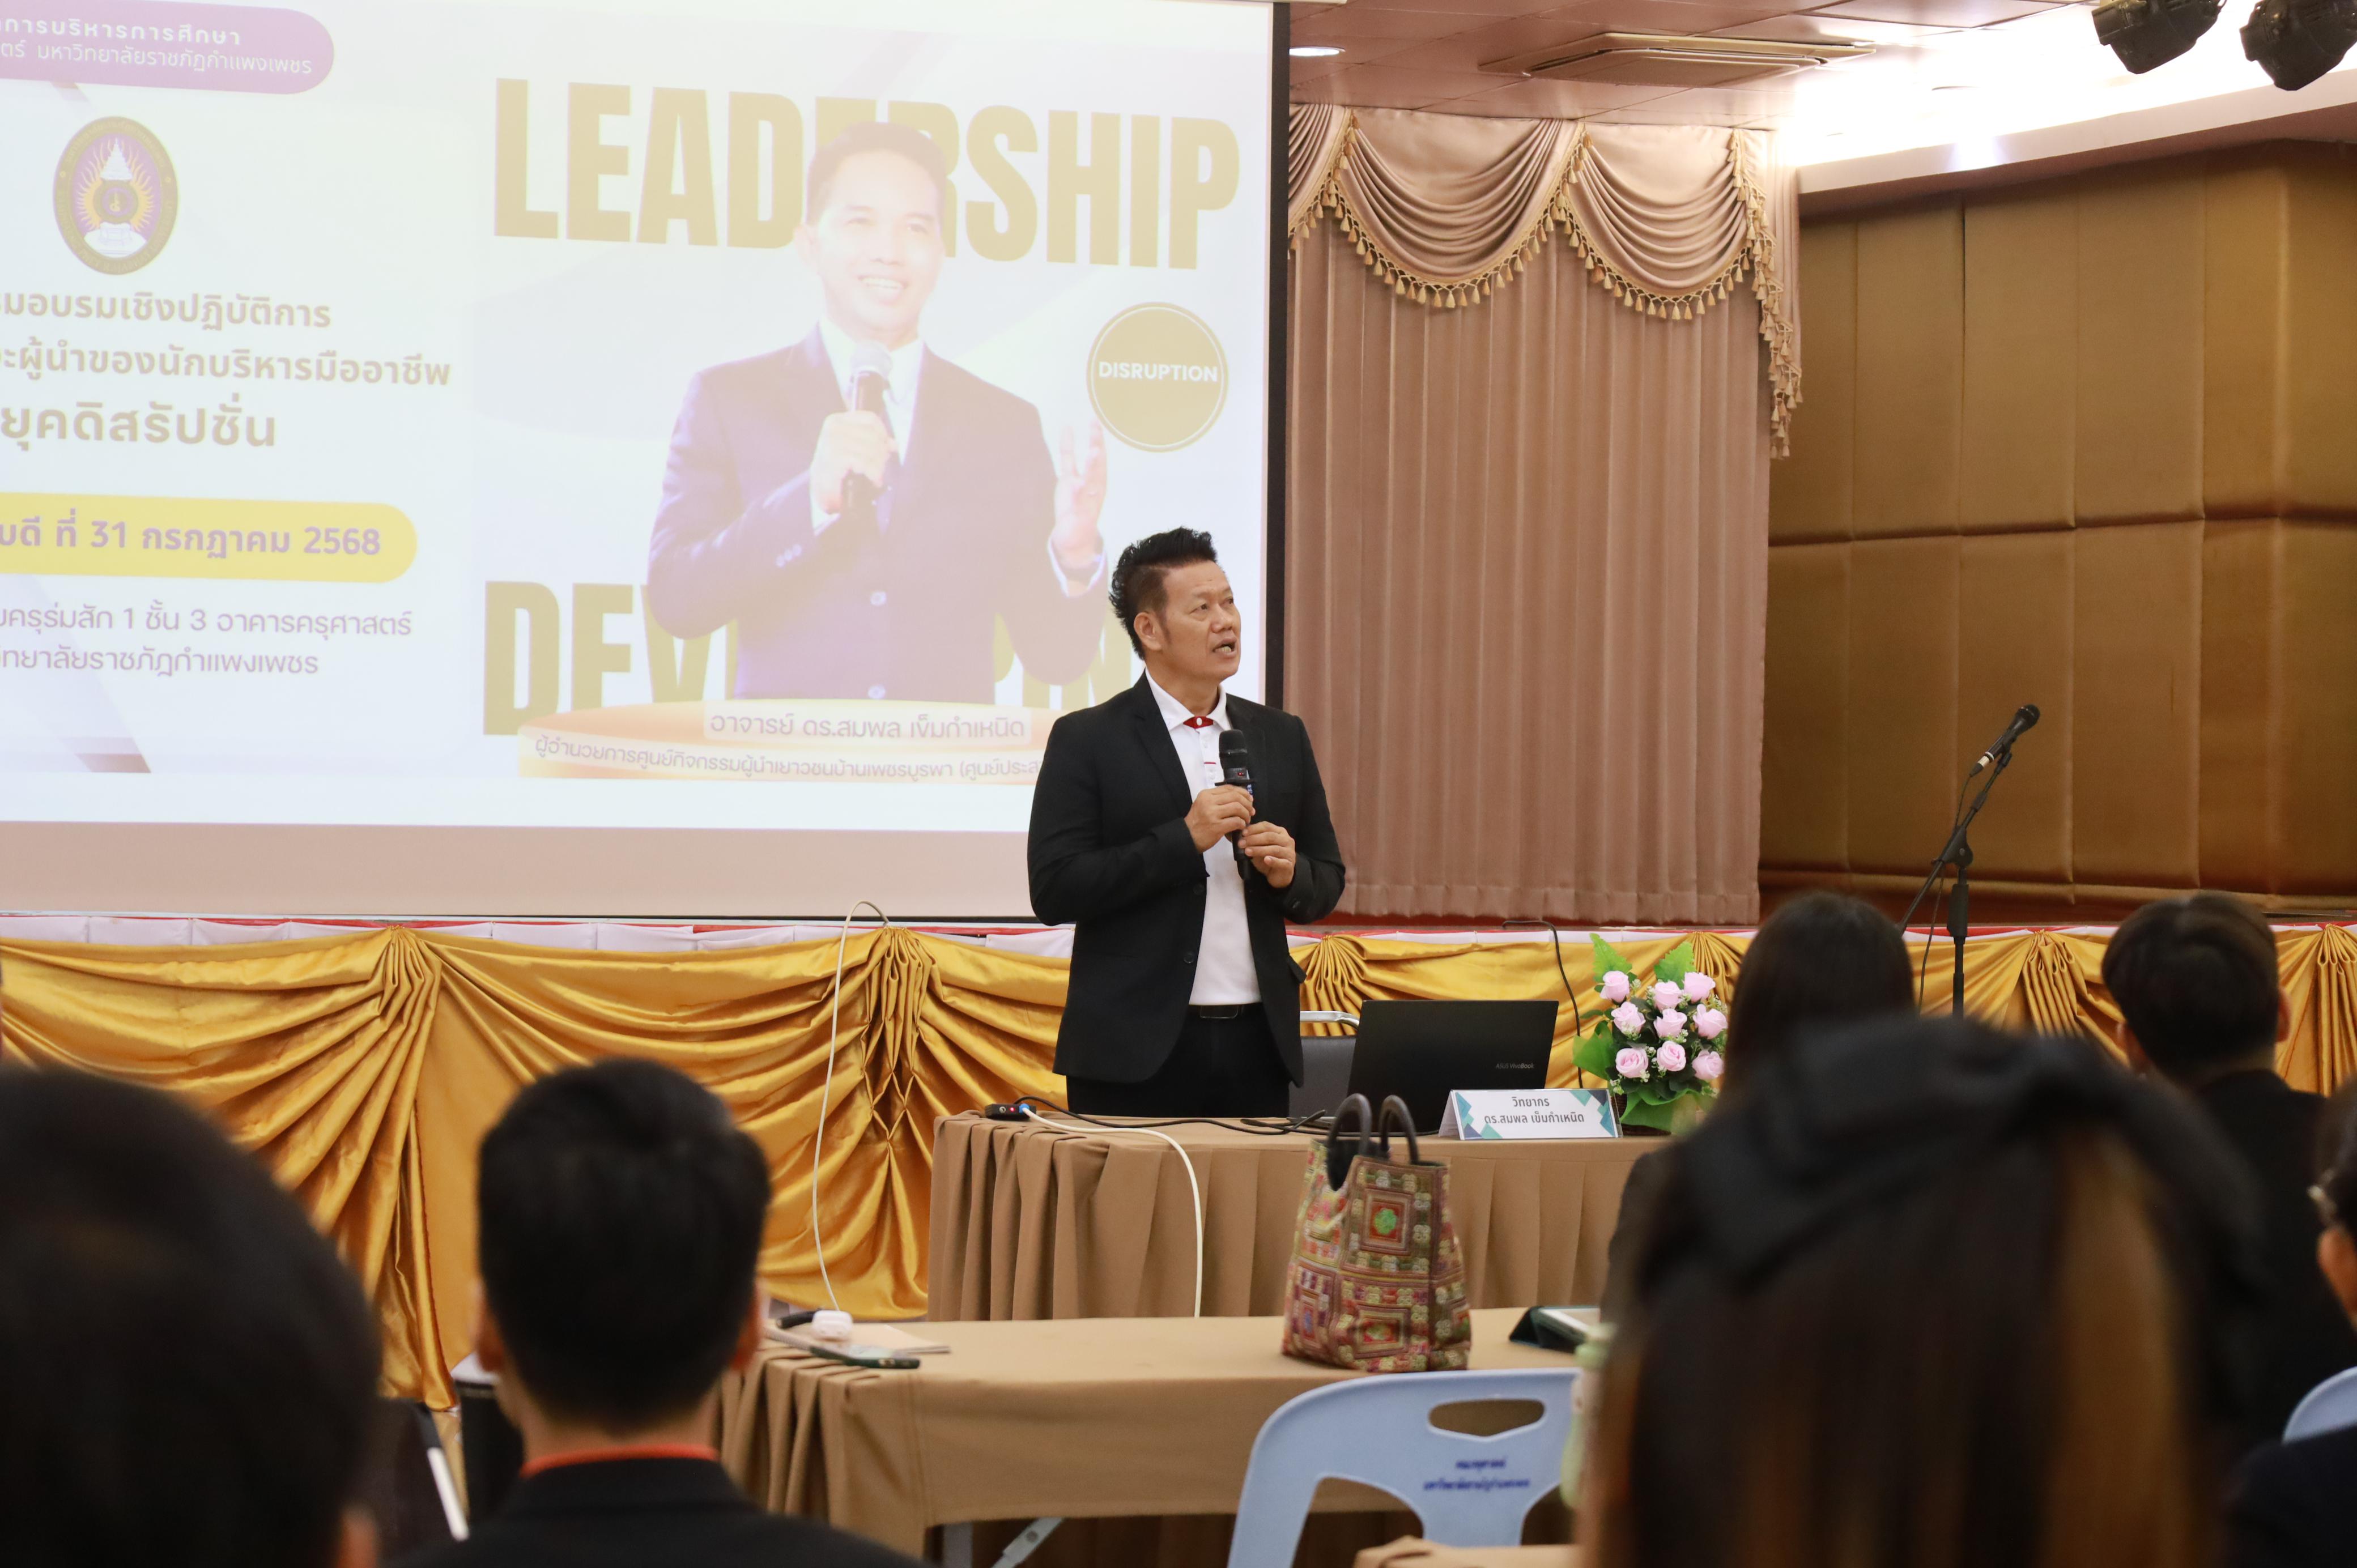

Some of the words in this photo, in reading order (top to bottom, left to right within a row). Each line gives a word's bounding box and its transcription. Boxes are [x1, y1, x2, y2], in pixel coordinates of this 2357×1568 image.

[0, 19, 240, 46] การบริหารการศึกษา
[0, 291, 331, 331] มอบรมเชิงปฏิบัติการ
[0, 335, 450, 386] ะผู้นำของนักบริหารมืออาชีพ
[1098, 360, 1219, 383] DISRUPTION
[56, 508, 76, 547] ที่
[91, 520, 126, 548] 31
[303, 527, 381, 556] 2568
[123, 607, 134, 629] 1
[146, 599, 180, 630] ชั้น
[190, 609, 207, 631] 3
[216, 611, 412, 641] อาคารครุศาสตร์
[710, 713, 794, 736] อาจารย์
[802, 719, 901, 738] ดร.สมพล
[910, 714, 1025, 739] เข็มกำเหนิด
[960, 757, 1041, 781] (ศูนย์ประส
[1512, 1096, 1550, 1107] วิทยากร
[1484, 1114, 1528, 1124] ดร.สมพล
[1531, 1110, 1585, 1123] เข็มกำเหนิด
